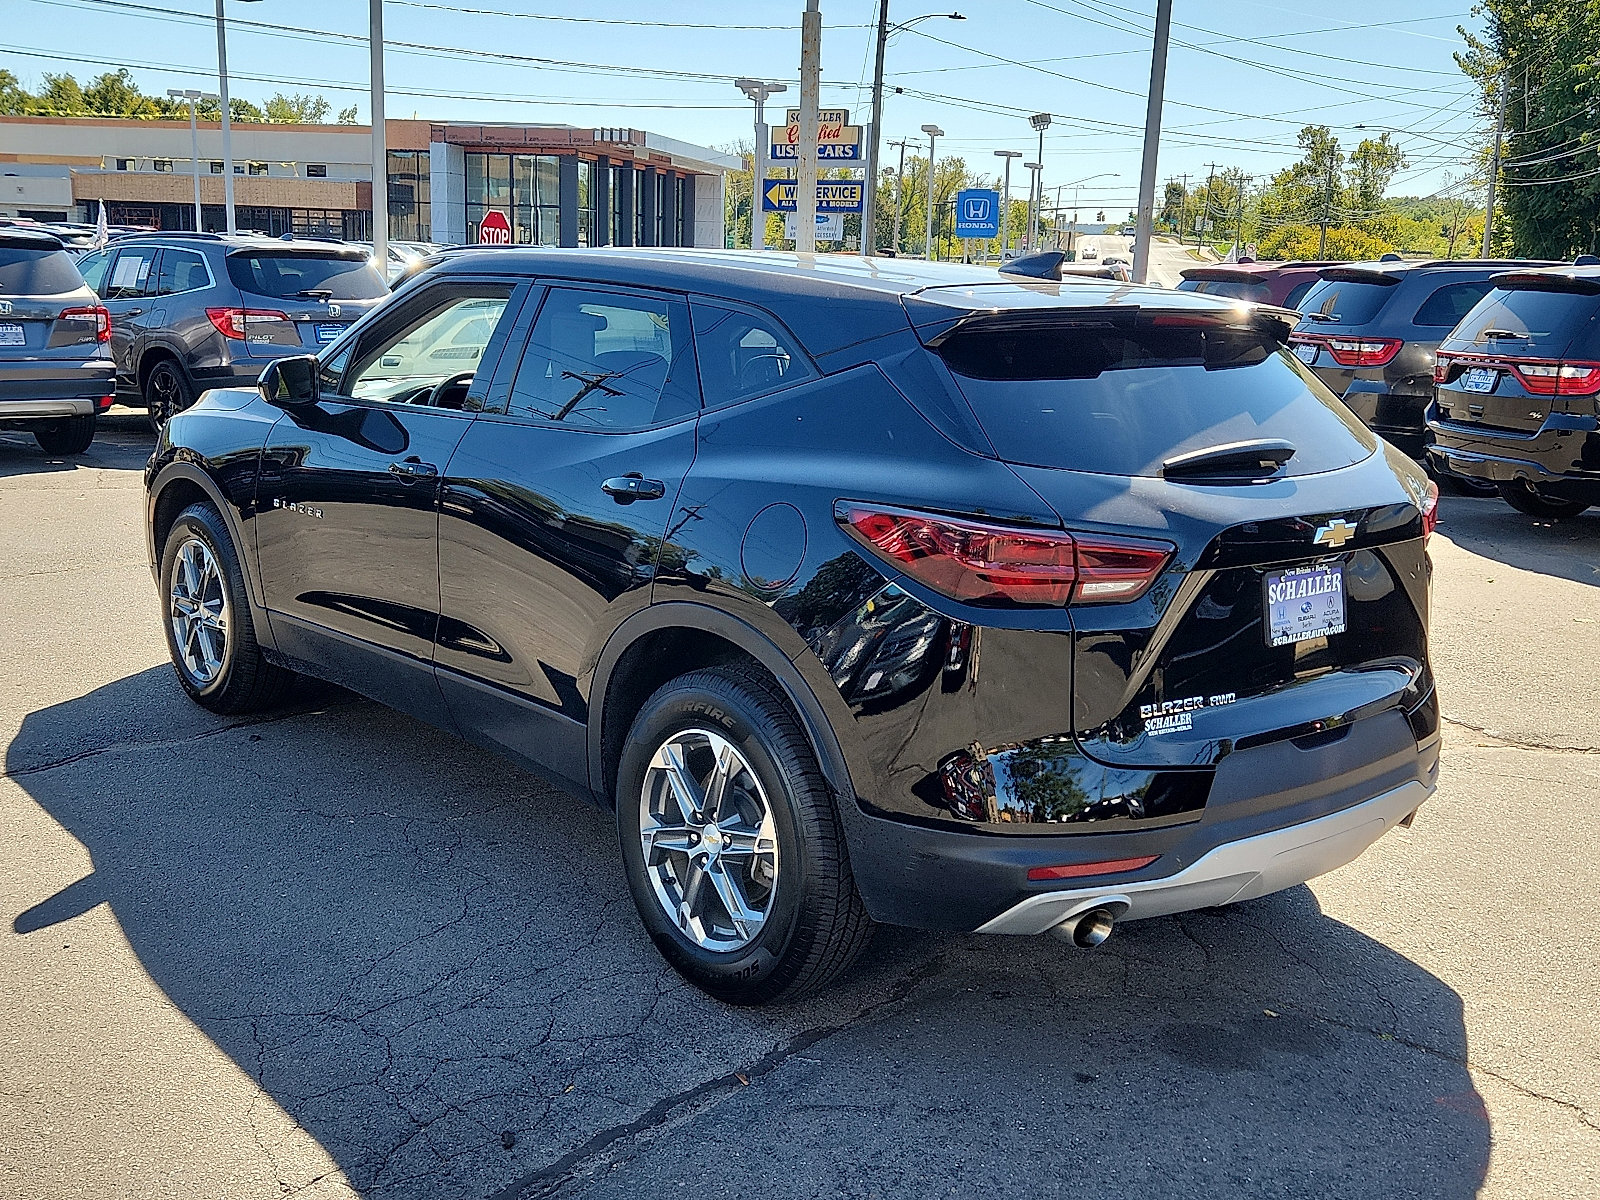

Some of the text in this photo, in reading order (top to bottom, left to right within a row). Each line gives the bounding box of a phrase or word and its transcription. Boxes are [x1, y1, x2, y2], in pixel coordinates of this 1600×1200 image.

[790, 112, 841, 123] SCLLER
[816, 145, 853, 157] CARS
[784, 187, 857, 199] W ERVICE
[481, 226, 509, 245] STOP
[273, 498, 323, 519] BLAZER
[1268, 573, 1342, 605] SCHALLER
[1140, 692, 1237, 719] BLAZER AWD
[1144, 712, 1193, 732] SCHALLER
